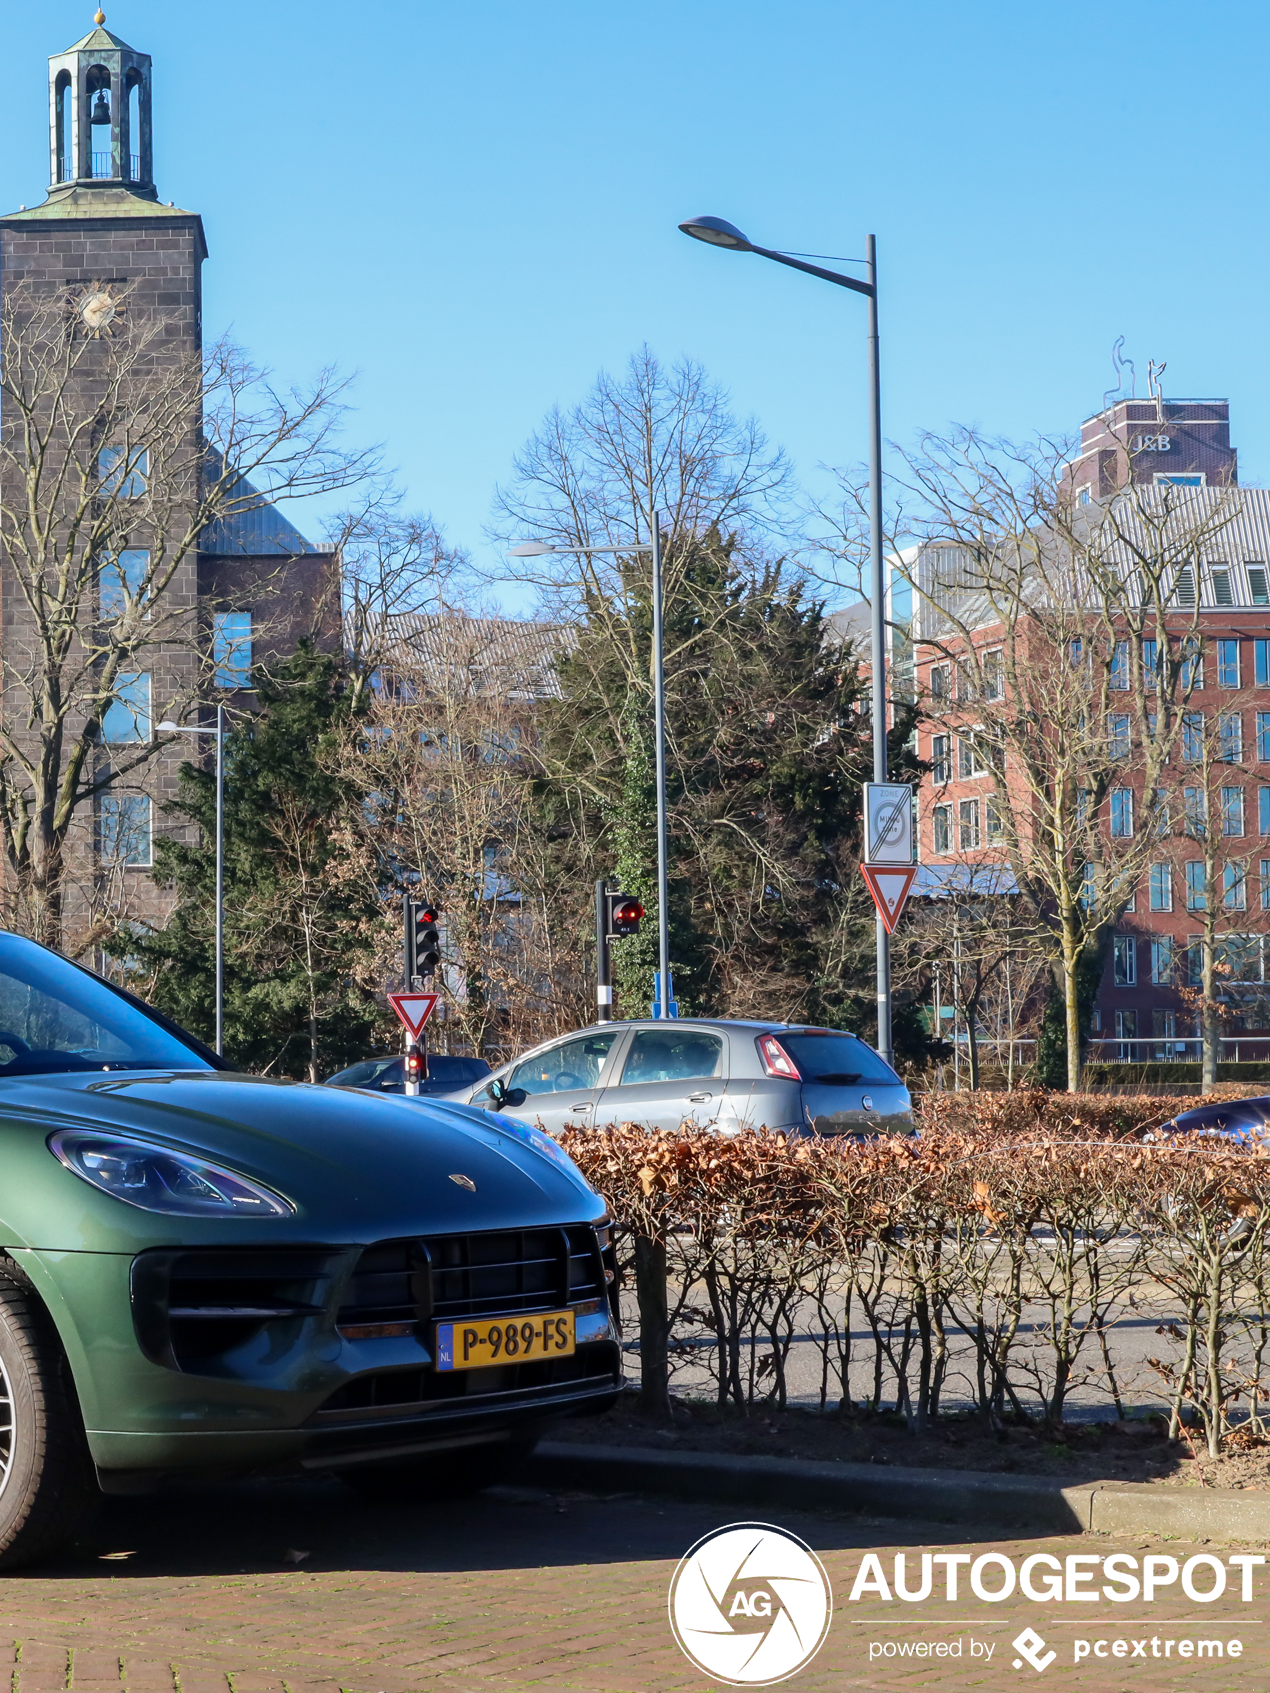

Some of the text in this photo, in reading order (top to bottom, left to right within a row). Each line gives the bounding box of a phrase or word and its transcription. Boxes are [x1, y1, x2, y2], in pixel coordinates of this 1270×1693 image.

[1133, 434, 1171, 452] J&B
[880, 789, 899, 798] ZONE
[463, 1317, 568, 1361] P-989-FS
[440, 1352, 452, 1362] NL
